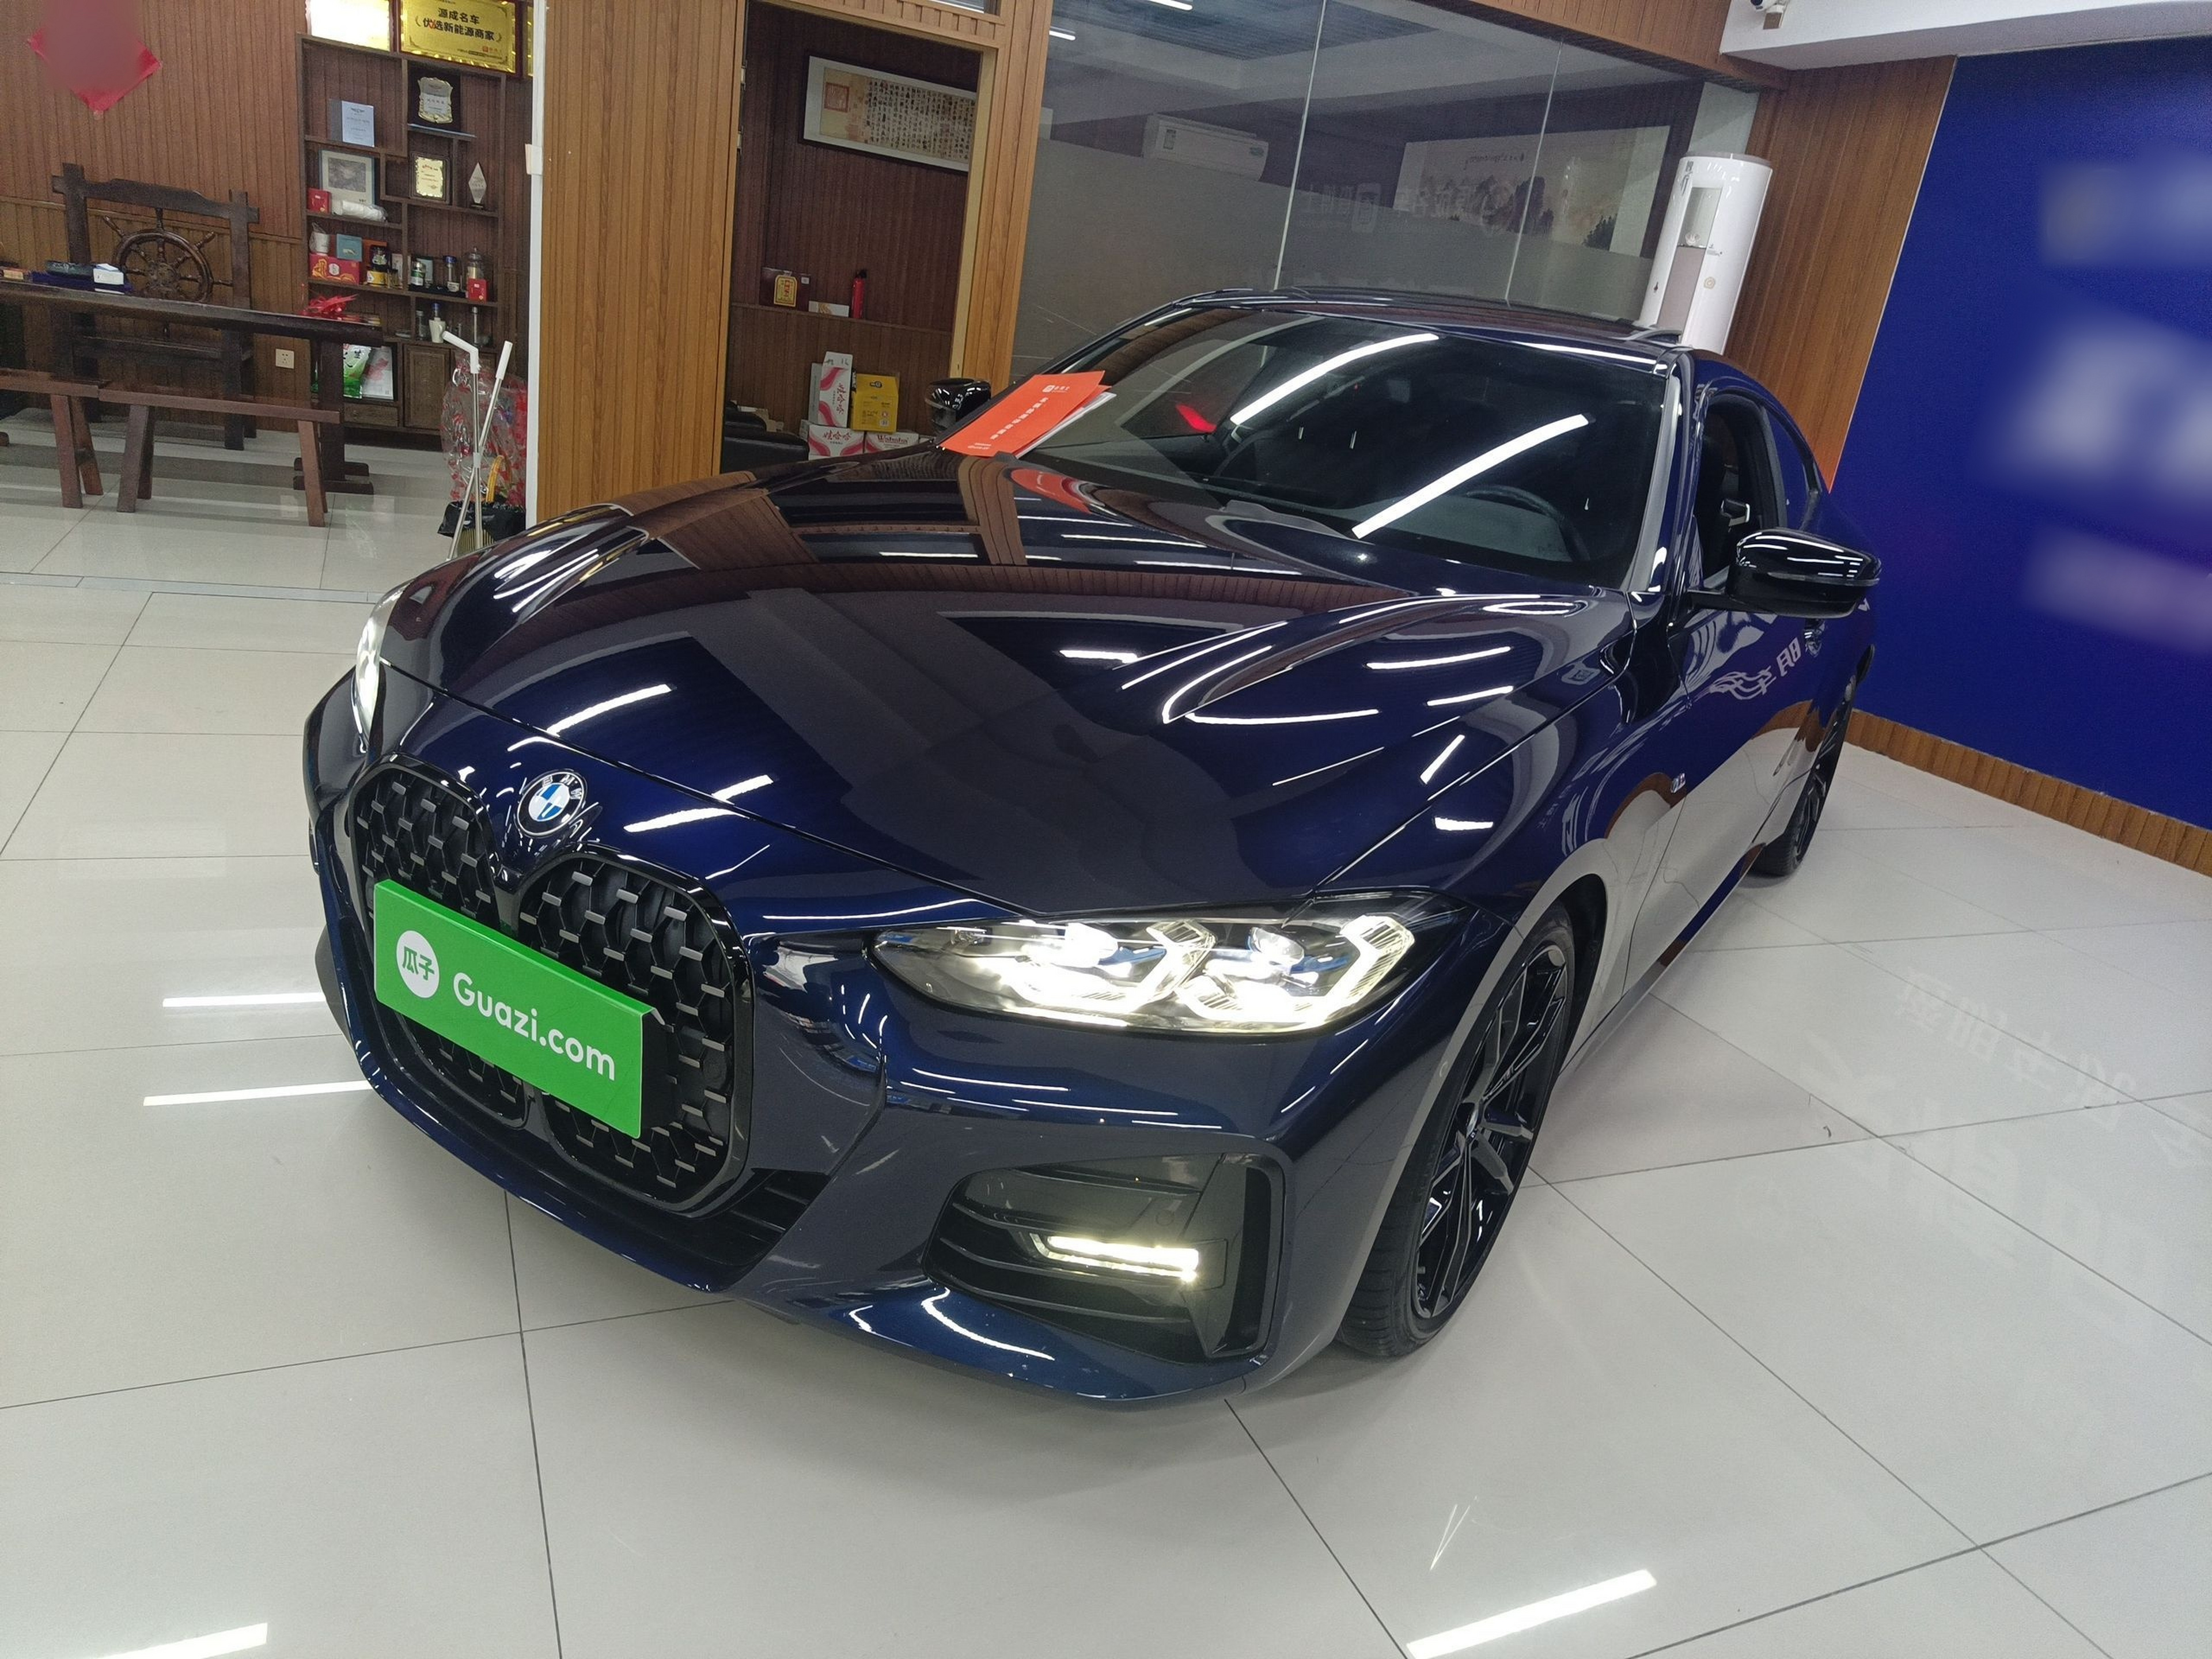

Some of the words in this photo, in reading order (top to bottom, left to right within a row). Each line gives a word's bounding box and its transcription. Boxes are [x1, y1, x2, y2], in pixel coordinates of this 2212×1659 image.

[438, 7, 480, 25] 源成名车
[823, 430, 851, 441] 娃哈哈
[541, 774, 582, 800] BMW
[402, 945, 435, 983] 瓜子
[453, 972, 616, 1081] Guazi.com
